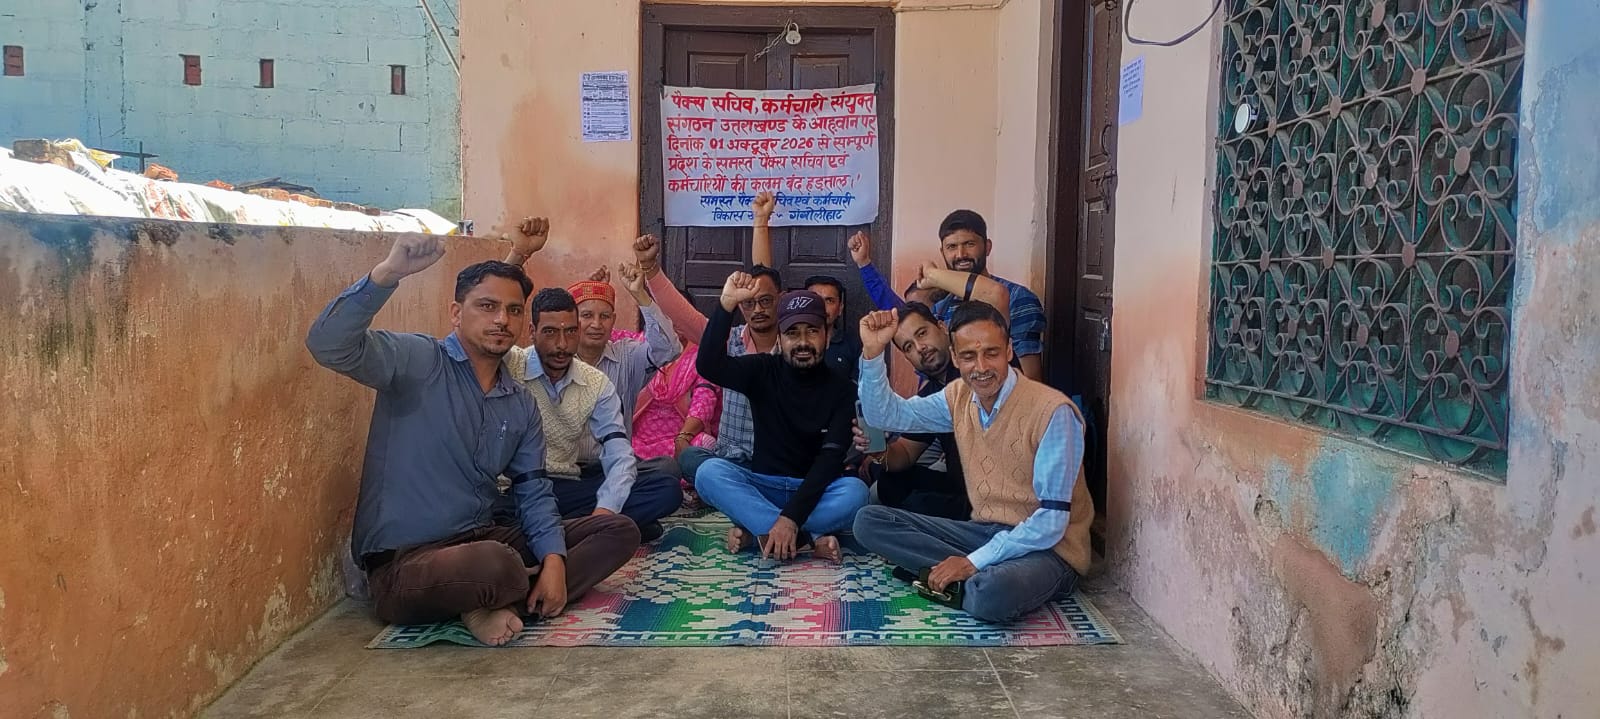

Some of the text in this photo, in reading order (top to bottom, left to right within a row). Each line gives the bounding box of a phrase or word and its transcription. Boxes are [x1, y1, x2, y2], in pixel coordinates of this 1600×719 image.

[761, 93, 828, 116] कर्मचारी
[831, 91, 875, 114] संयुक्त
[666, 113, 717, 133] संगठन
[721, 117, 788, 135] उत्तराखण्ड
[792, 114, 808, 131] के
[862, 115, 877, 131] पर
[667, 134, 706, 153] दिनांक
[709, 138, 724, 150] 01
[781, 137, 815, 150] 2026
[817, 134, 832, 150] से
[833, 131, 877, 152] सम्पूर्ण
[668, 154, 700, 175] प्रदेश
[701, 152, 714, 171] के
[715, 156, 756, 173] समस्त
[790, 152, 826, 170] सचिव
[826, 151, 850, 168] एवं
[668, 174, 728, 194] कर्मचारियों
[730, 174, 749, 193] की
[750, 177, 785, 192] कलम
[786, 174, 806, 194] बंद
[700, 195, 736, 208] समस्त
[812, 192, 855, 208] कर्मचारी
[712, 207, 747, 222] विकास
